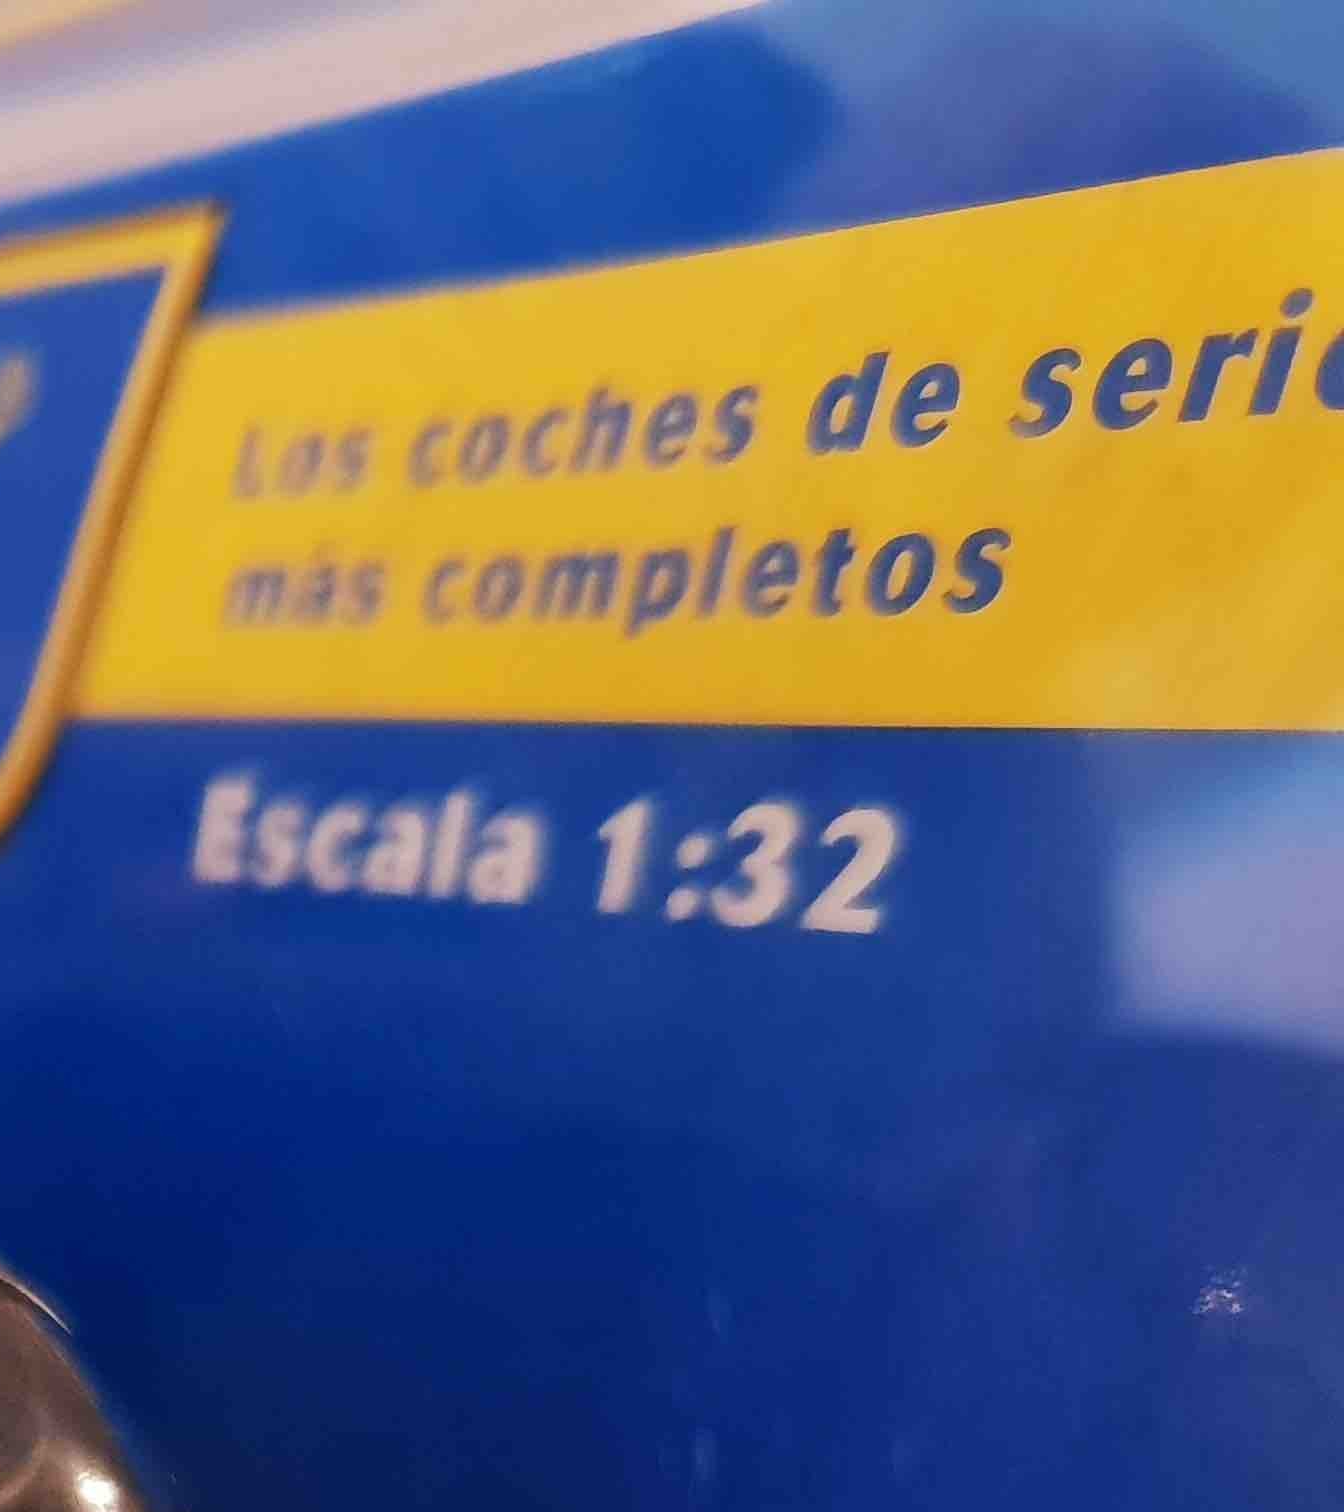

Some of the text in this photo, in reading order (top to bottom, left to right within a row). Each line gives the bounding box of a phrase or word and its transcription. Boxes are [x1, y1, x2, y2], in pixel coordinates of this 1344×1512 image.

[230, 420, 374, 502] Los
[406, 378, 761, 490] coches
[804, 350, 962, 456] de
[222, 522, 1014, 640] más completos
[192, 774, 900, 935] Escala 1:32
